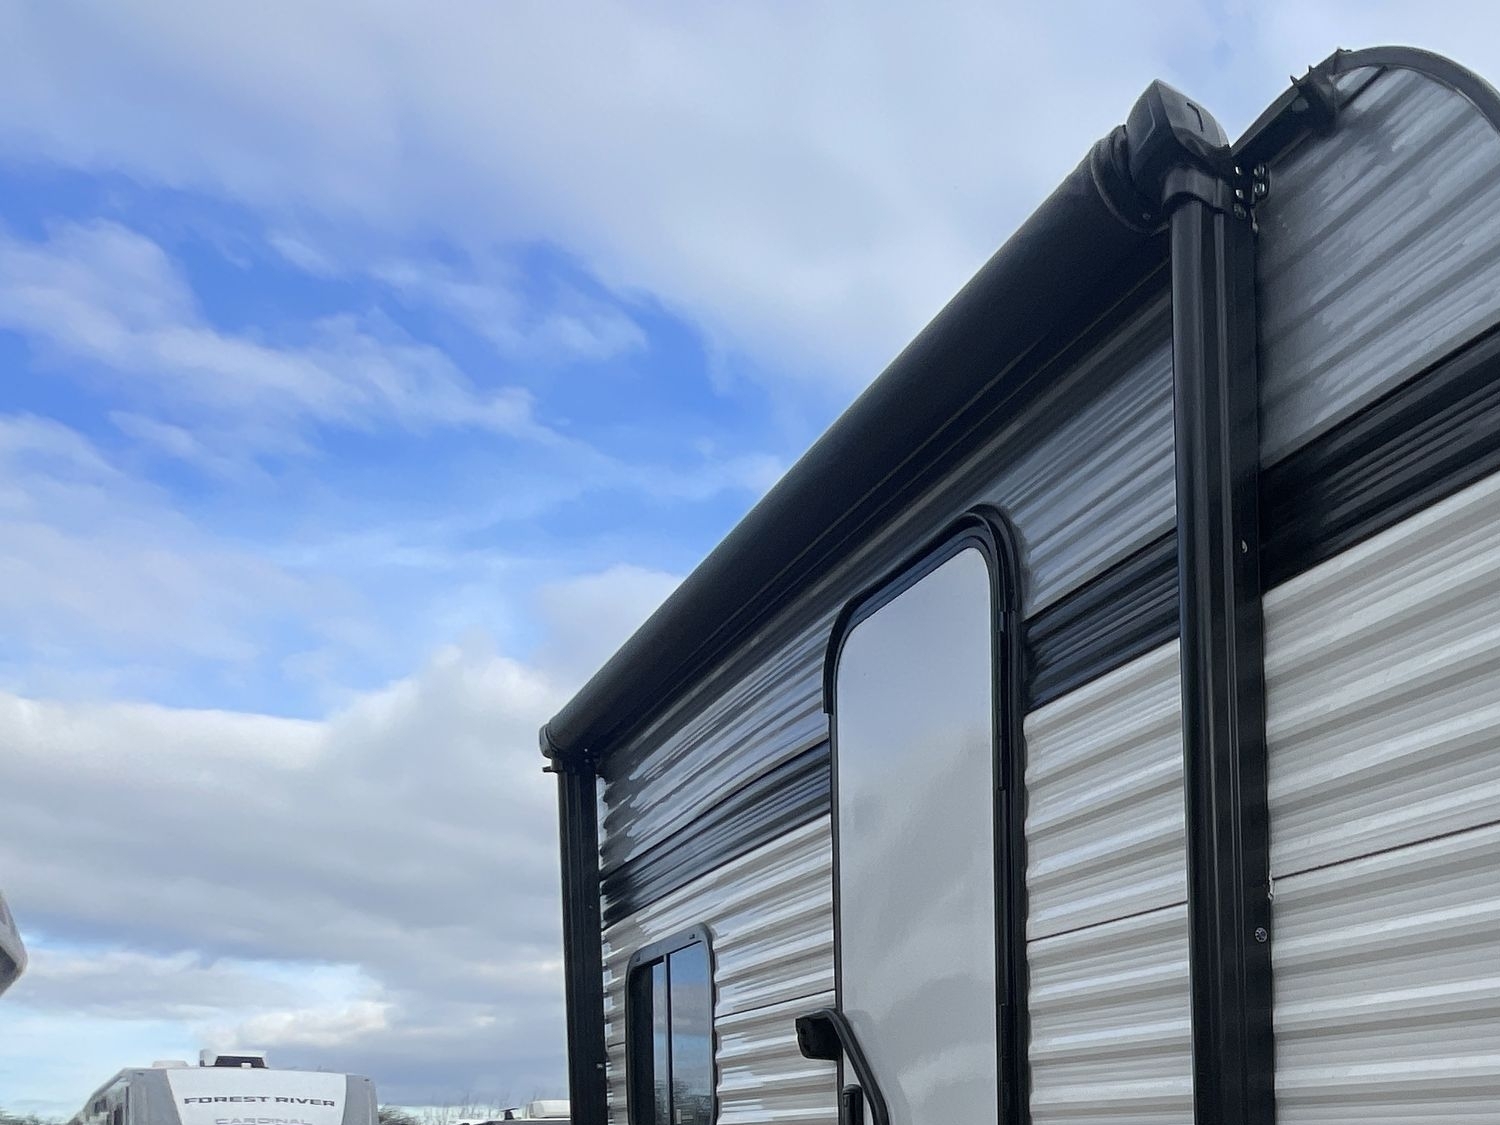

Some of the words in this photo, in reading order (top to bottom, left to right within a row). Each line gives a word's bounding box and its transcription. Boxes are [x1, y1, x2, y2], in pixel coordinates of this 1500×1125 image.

[184, 1096, 271, 1104] FOREST
[275, 1097, 335, 1107] RIVER
[215, 1117, 313, 1125] CARDINAL
